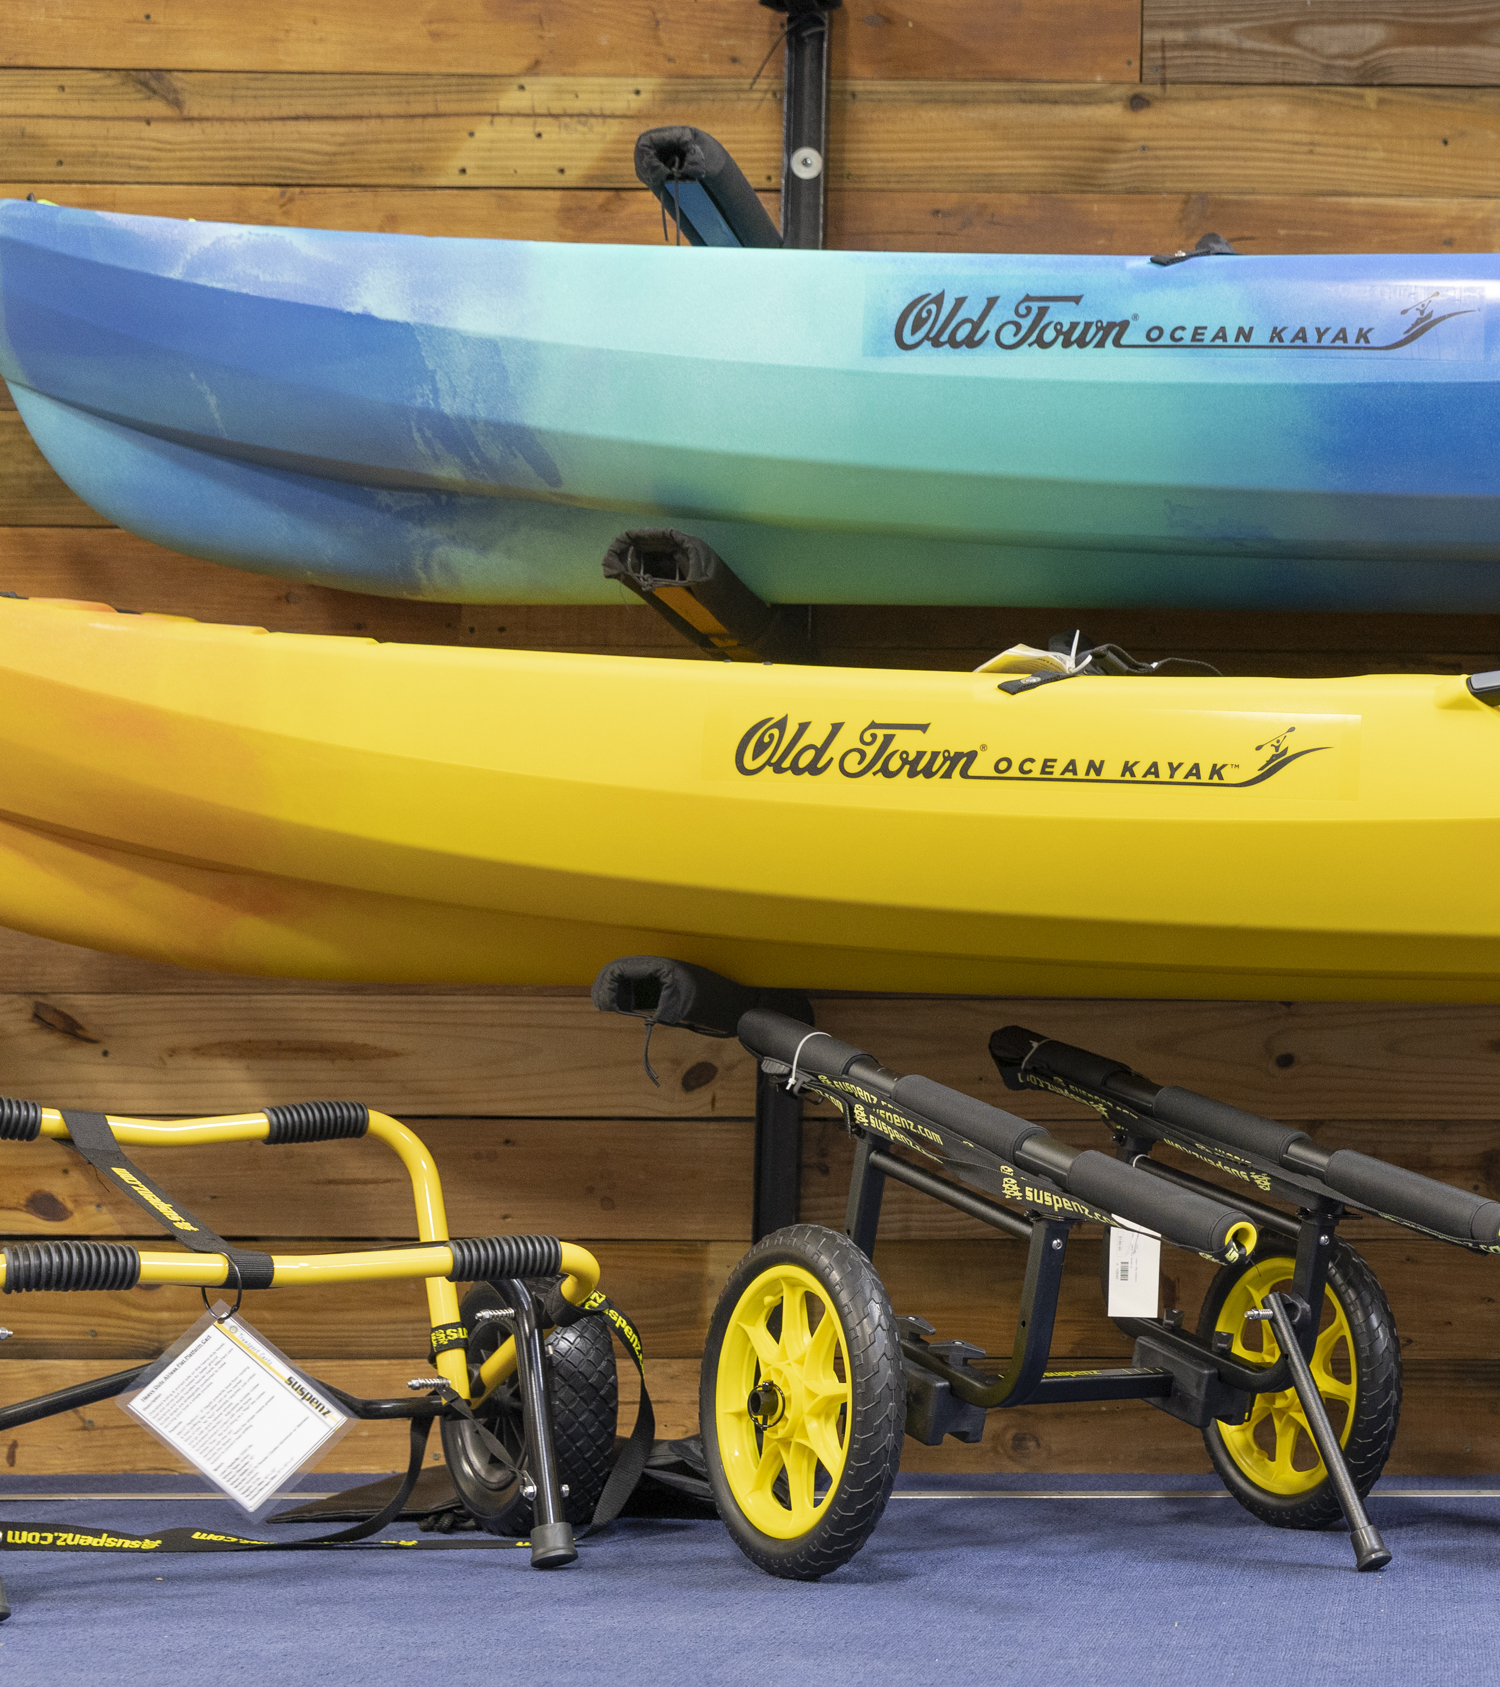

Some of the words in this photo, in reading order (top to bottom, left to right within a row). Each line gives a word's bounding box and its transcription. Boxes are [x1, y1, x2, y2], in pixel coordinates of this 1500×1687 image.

[894, 288, 1000, 350] Old
[1145, 325, 1254, 343] OCEAN
[1268, 325, 1374, 345] KAYAK
[735, 713, 845, 777] Old
[993, 756, 1105, 777] OCEAN
[284, 1375, 332, 1418] suspenz
[6, 1530, 142, 1549] suspenz.com
